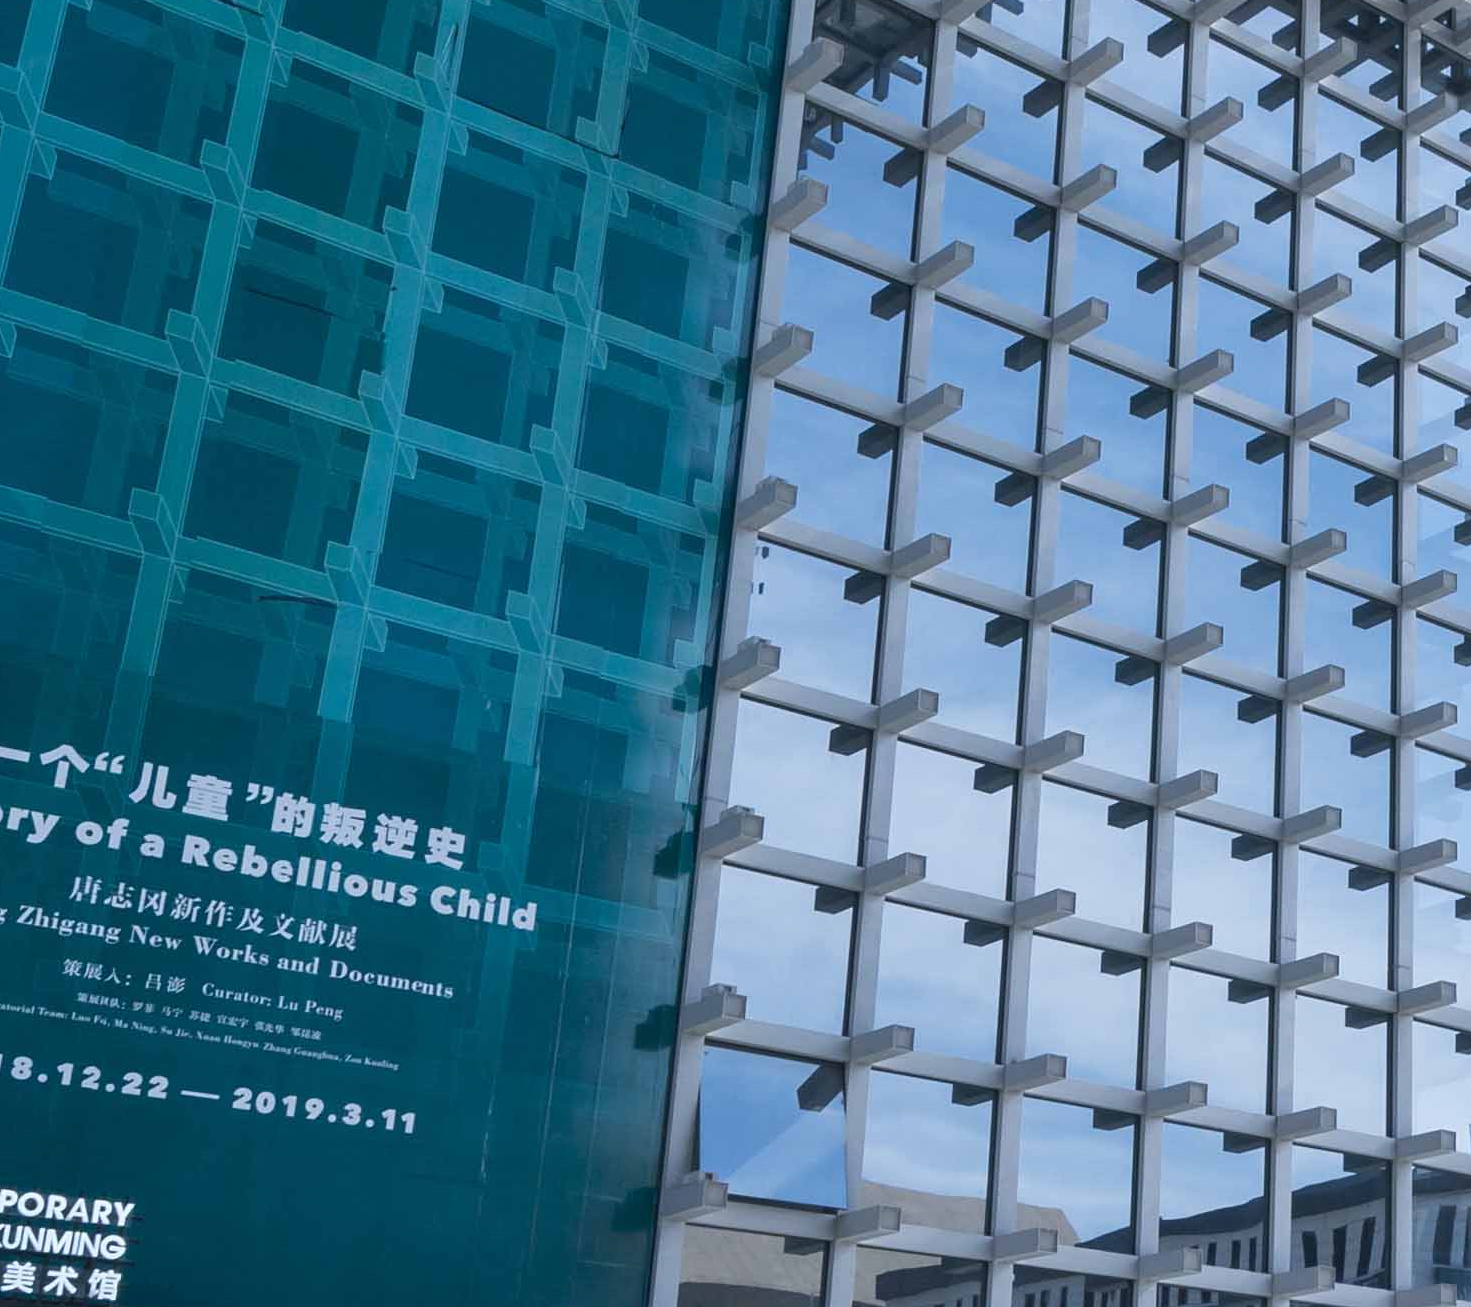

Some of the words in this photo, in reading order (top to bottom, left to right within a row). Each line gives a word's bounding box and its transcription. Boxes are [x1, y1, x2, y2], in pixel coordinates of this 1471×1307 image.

[75, 818, 130, 851] of
[140, 833, 166, 859] a
[181, 834, 418, 908] Rebellious
[430, 885, 538, 933] Child
[69, 875, 358, 952] 唐志冈新作及文献展
[16, 904, 122, 945] Zhigang
[129, 924, 182, 951] New
[193, 935, 269, 966] Works
[277, 956, 320, 976] and
[329, 959, 454, 1000] Documents
[144, 972, 186, 994] 吕澎
[201, 982, 272, 1007] Curator:
[278, 995, 299, 1012] Lu
[304, 999, 345, 1022] Peng
[232, 1086, 417, 1134] 2019.3.11
